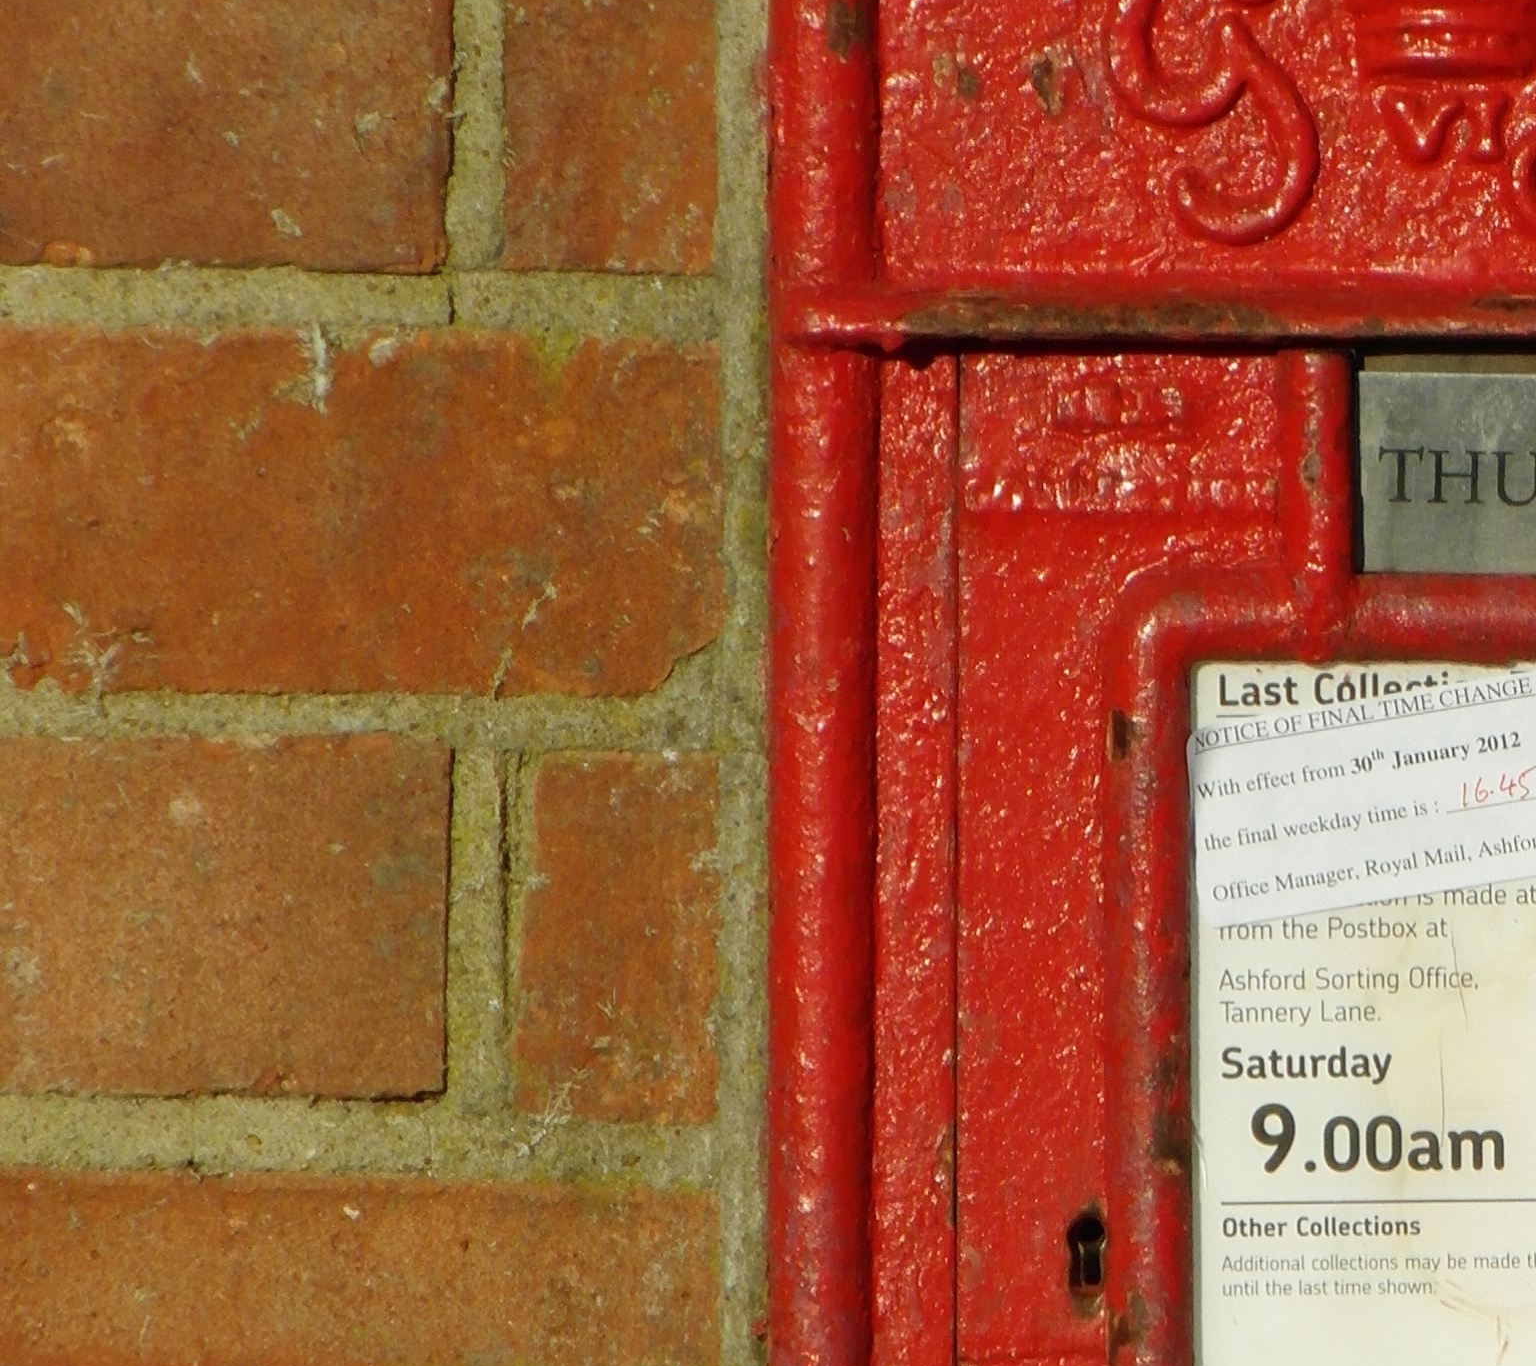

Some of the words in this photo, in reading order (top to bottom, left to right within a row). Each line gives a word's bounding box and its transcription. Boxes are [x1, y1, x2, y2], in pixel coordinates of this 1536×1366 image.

[1218, 673, 1299, 706] Last
[1194, 719, 1270, 752] NOTICE
[1274, 715, 1303, 735] OF
[1308, 704, 1375, 730] FINAL
[1378, 692, 1435, 719] TIME
[1439, 676, 1533, 707] CHANGE
[1196, 777, 1242, 800] With
[1246, 769, 1297, 792] effect
[1301, 760, 1346, 783] from
[1350, 748, 1385, 775] 30th
[1391, 743, 1471, 770] January
[1475, 731, 1523, 755] 2012
[1204, 833, 1233, 852] the
[1237, 822, 1278, 846] final
[1283, 812, 1362, 838] weekday
[1368, 805, 1408, 825] time
[1412, 800, 1428, 817] is
[1212, 879, 1270, 903] Office
[1274, 865, 1361, 893] Manager,
[1364, 852, 1419, 878] Royal
[1423, 844, 1472, 868] Mail,
[1442, 884, 1508, 906] made
[1282, 917, 1318, 940] the
[1327, 915, 1418, 940] Postbox
[1425, 918, 1449, 939] at
[1218, 967, 1306, 992] Ashford
[1314, 966, 1400, 995] Sorting
[1408, 965, 1480, 991] Office,
[1219, 999, 1312, 1027] Tannery
[1320, 999, 1382, 1024] Lane.
[1220, 1045, 1393, 1085] Saturday
[1250, 1102, 1506, 1174] 9.00am
[1222, 1216, 1288, 1238] Other
[1296, 1215, 1422, 1238] Collections
[1221, 1254, 1305, 1272] Additional
[1311, 1254, 1398, 1272] collections
[1404, 1256, 1441, 1274] may
[1446, 1252, 1467, 1270] be
[1473, 1252, 1521, 1270] made
[1221, 1280, 1260, 1297] until
[1265, 1279, 1293, 1297] the
[1298, 1279, 1329, 1296] last
[1334, 1279, 1372, 1296] time
